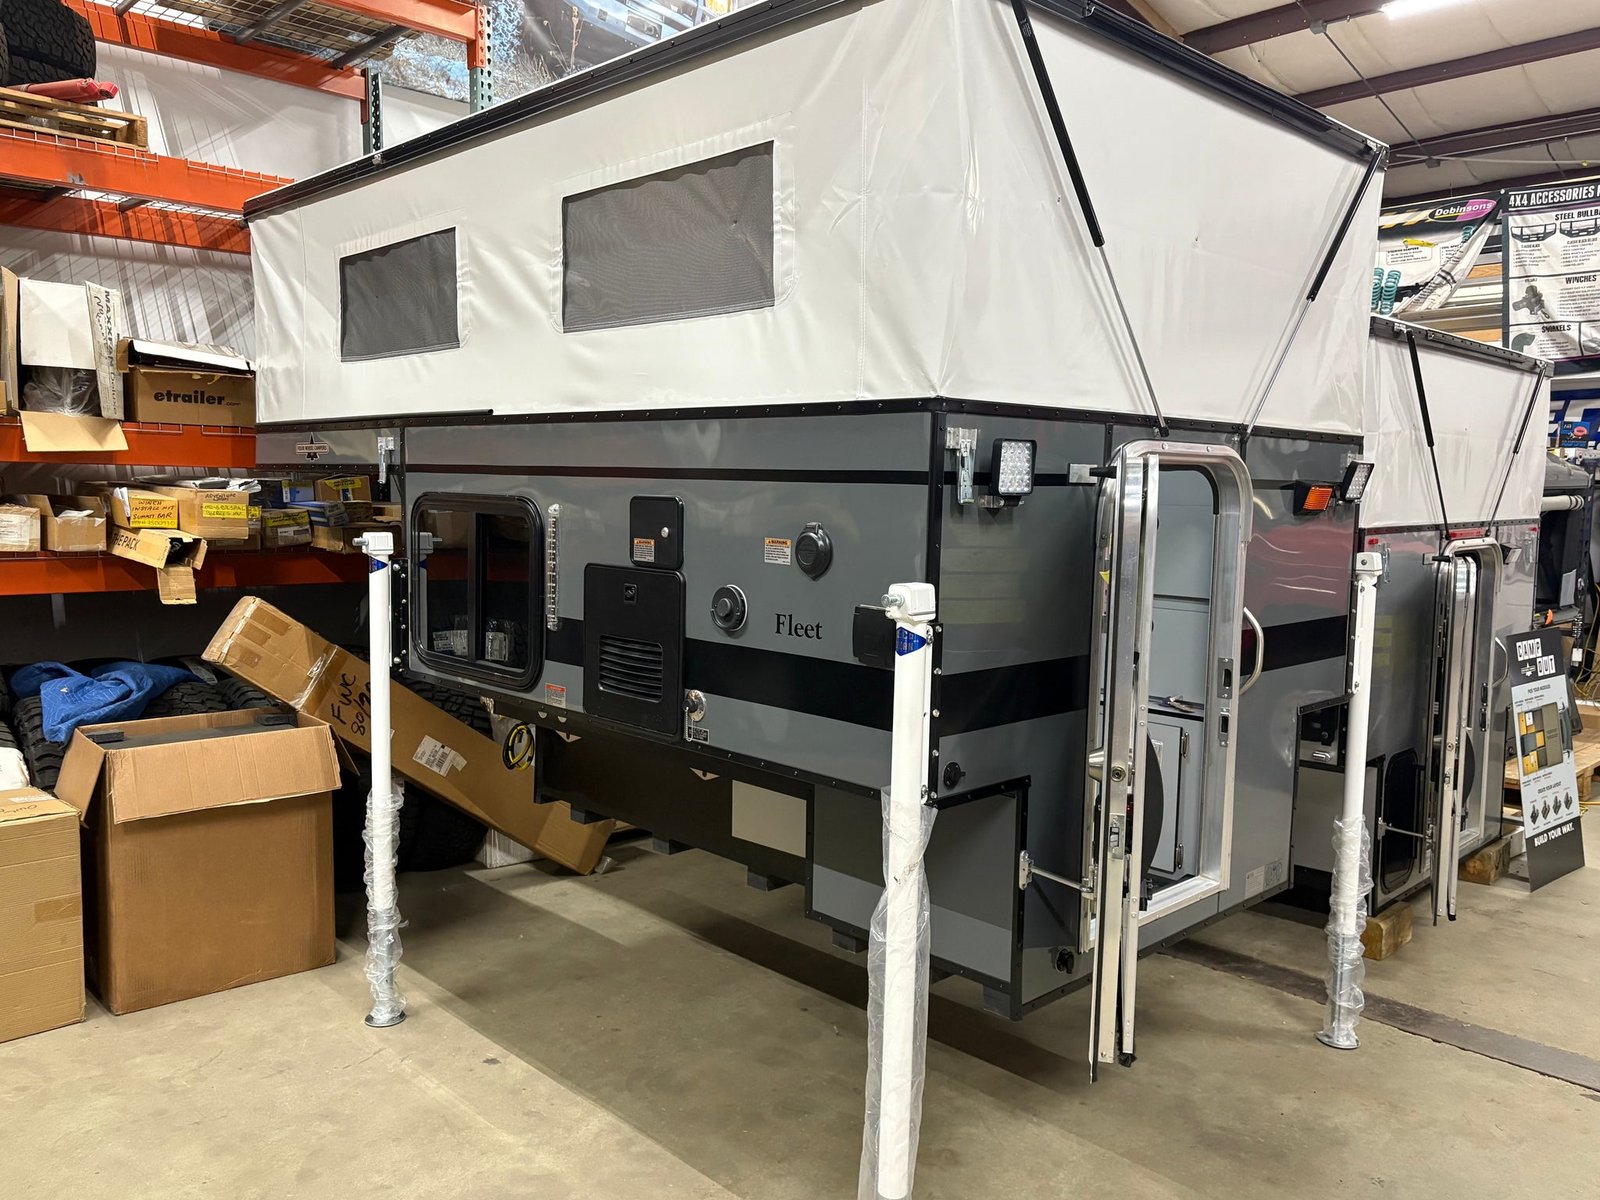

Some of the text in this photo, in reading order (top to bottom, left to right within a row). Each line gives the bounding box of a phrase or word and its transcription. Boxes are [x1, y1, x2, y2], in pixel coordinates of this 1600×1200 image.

[1508, 186, 1595, 207] 4X4 ACCESSORIES
[1434, 203, 1493, 216] Dobinsons
[1554, 212, 1575, 221] STEEL
[1565, 274, 1597, 284] WINCHES
[104, 290, 114, 368] MAXXFAN
[1541, 324, 1571, 333] SNORKELS
[774, 613, 823, 640] Fleet
[1517, 641, 1541, 659] CAMP
[1538, 657, 1554, 674] OUT
[331, 673, 356, 725] FWC
[1534, 834, 1548, 847] BUILD
[1548, 828, 1561, 840] YOUR
